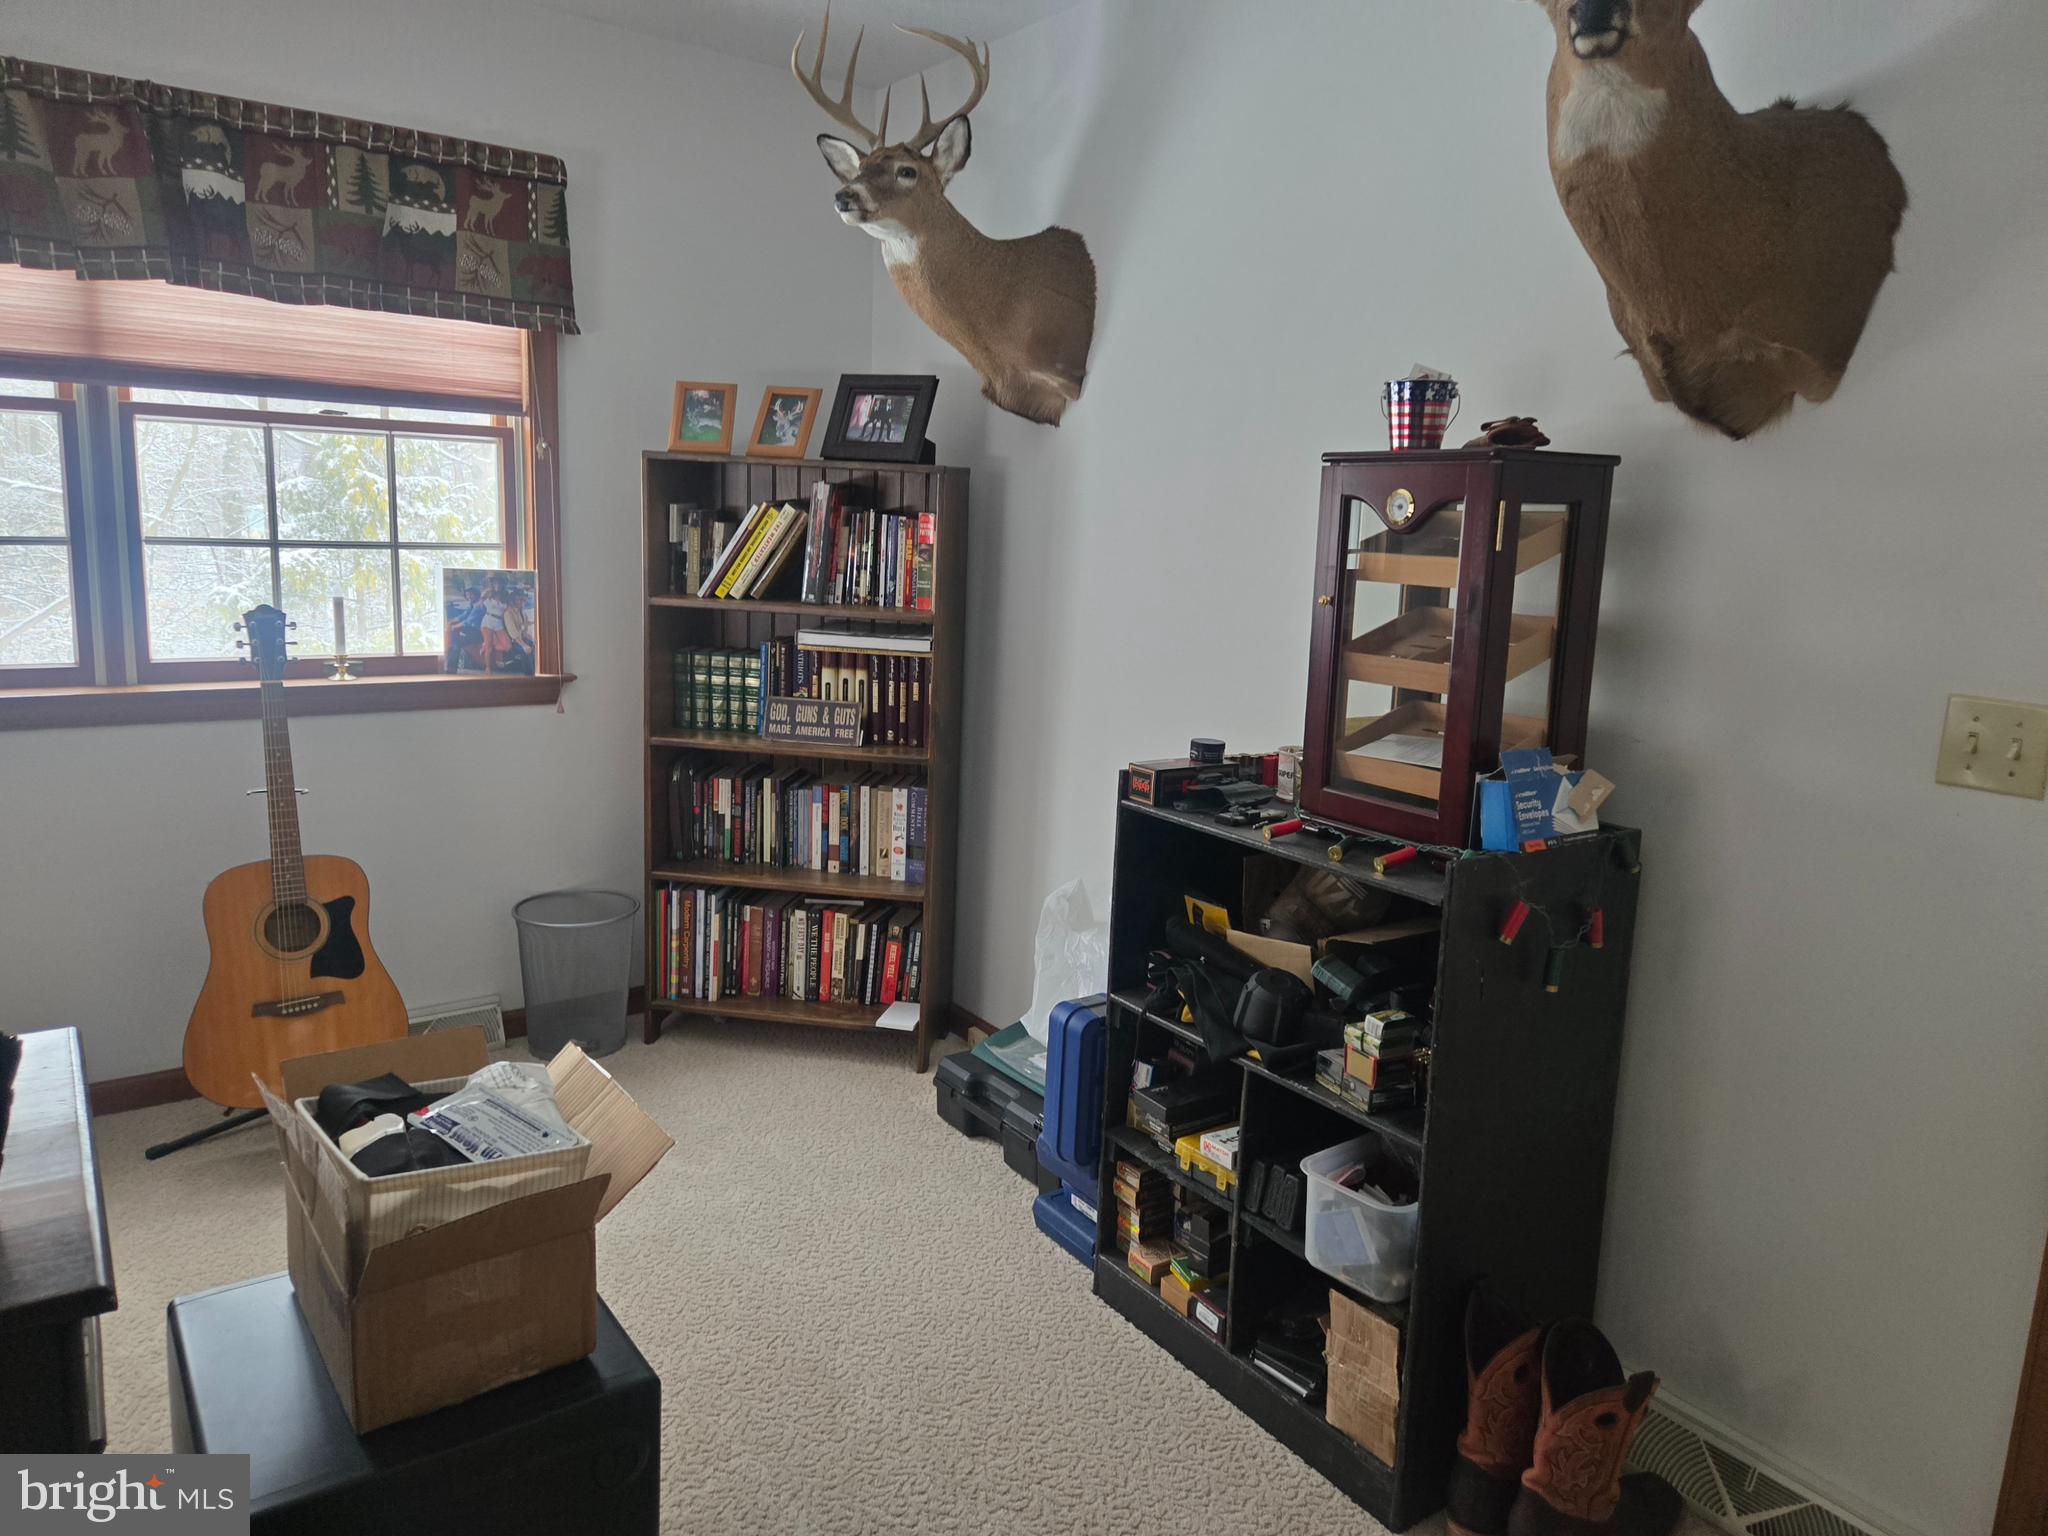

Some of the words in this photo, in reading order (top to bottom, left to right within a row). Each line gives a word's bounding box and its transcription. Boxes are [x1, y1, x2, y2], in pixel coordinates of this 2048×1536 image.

[796, 650, 805, 684] ATRIOTS
[770, 702, 790, 724] GOD,
[795, 703, 818, 724] GUNS
[823, 705, 830, 724] &
[834, 705, 856, 726] GUTS
[768, 723, 791, 735] MADE
[795, 725, 831, 738] AMERICA
[835, 727, 854, 739] FREE
[1515, 799, 1542, 811] Security
[910, 792, 918, 840] COMMENTARY
[1518, 809, 1549, 821] Envelopes
[683, 900, 692, 929] Modern
[797, 927, 805, 941] EASY
[810, 924, 819, 939] WE
[681, 930, 691, 969] Carpentry
[797, 942, 805, 954] DAY
[810, 939, 818, 956] THE
[809, 957, 818, 989] PEOPLE
